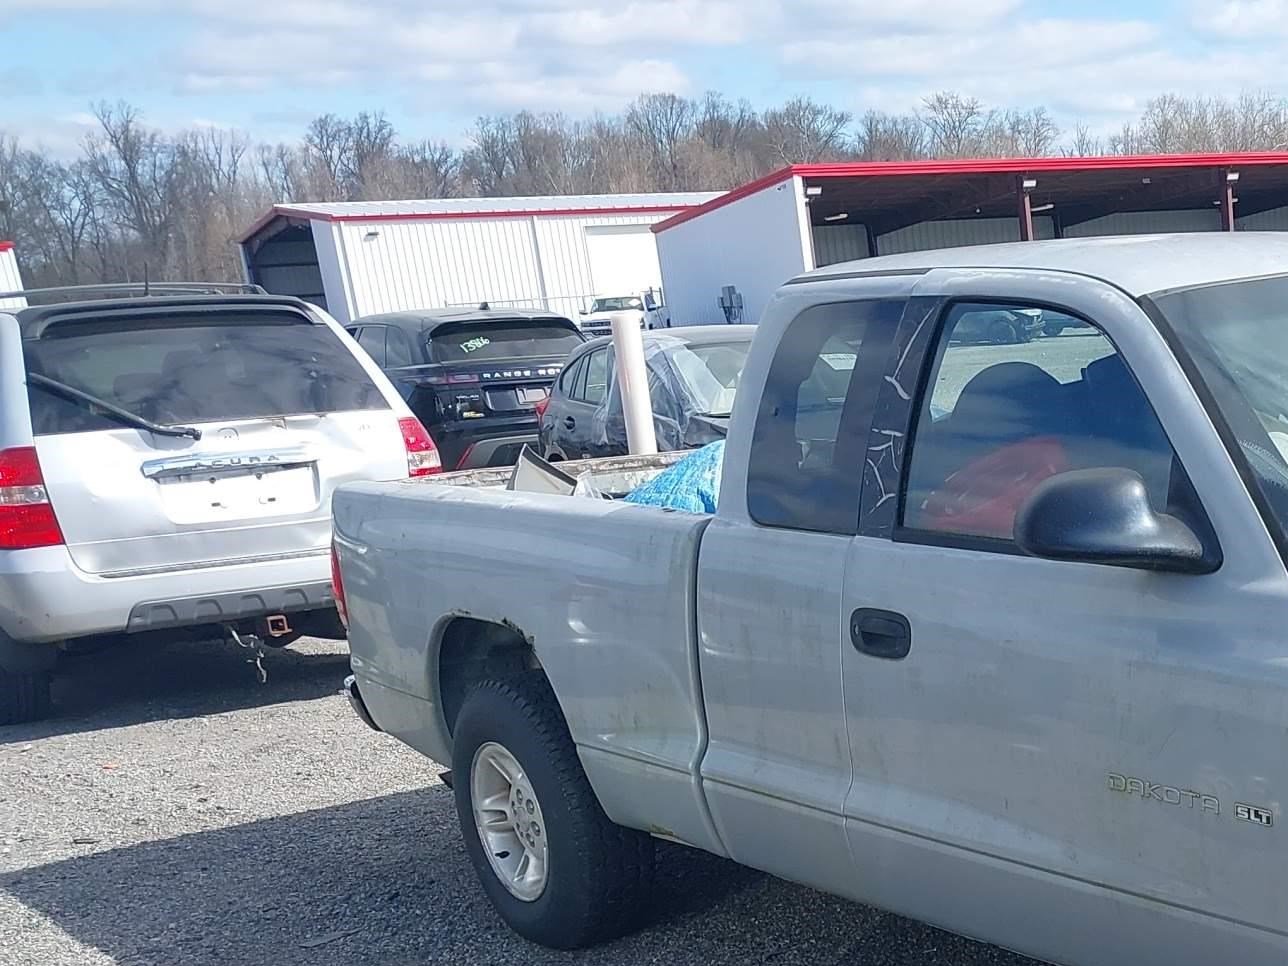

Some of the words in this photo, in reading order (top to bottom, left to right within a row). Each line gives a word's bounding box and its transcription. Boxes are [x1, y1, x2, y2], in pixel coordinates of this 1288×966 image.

[482, 370, 531, 379] RANGE
[192, 455, 280, 470] ACURA
[1106, 772, 1220, 815] DAKOTA
[1236, 804, 1272, 826] SLT
